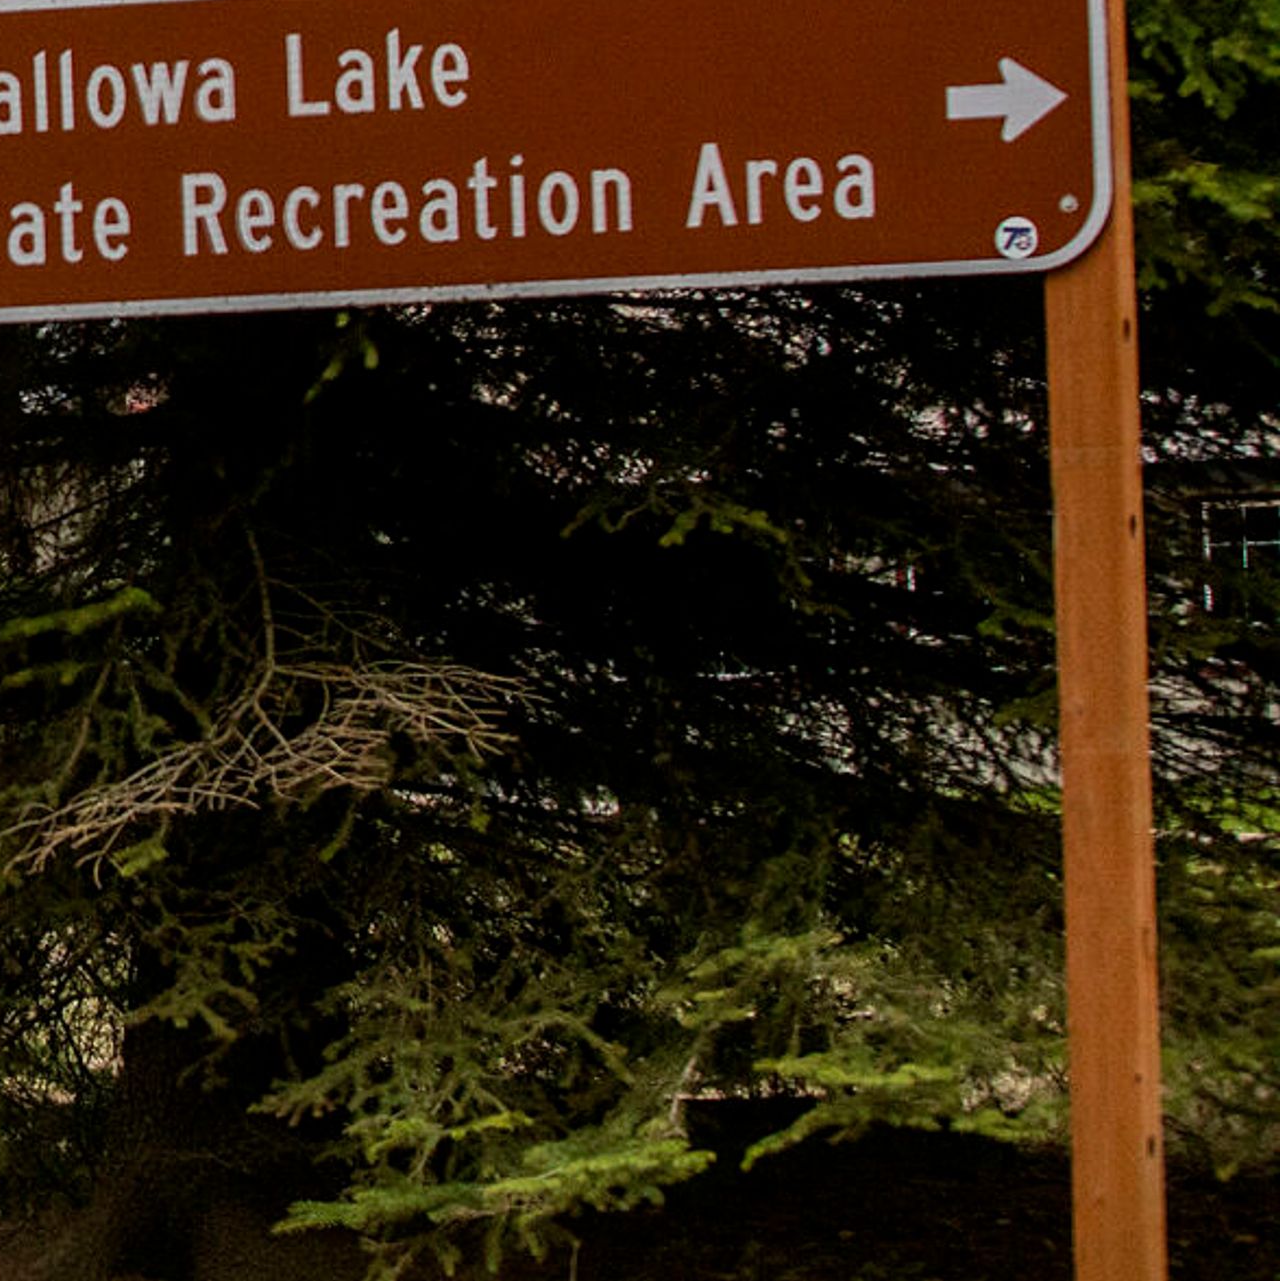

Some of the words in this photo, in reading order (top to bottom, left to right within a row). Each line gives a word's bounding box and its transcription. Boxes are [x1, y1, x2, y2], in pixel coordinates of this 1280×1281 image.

[286, 28, 469, 117] Lake
[182, 156, 632, 256] Recreation
[687, 142, 875, 228] Area
